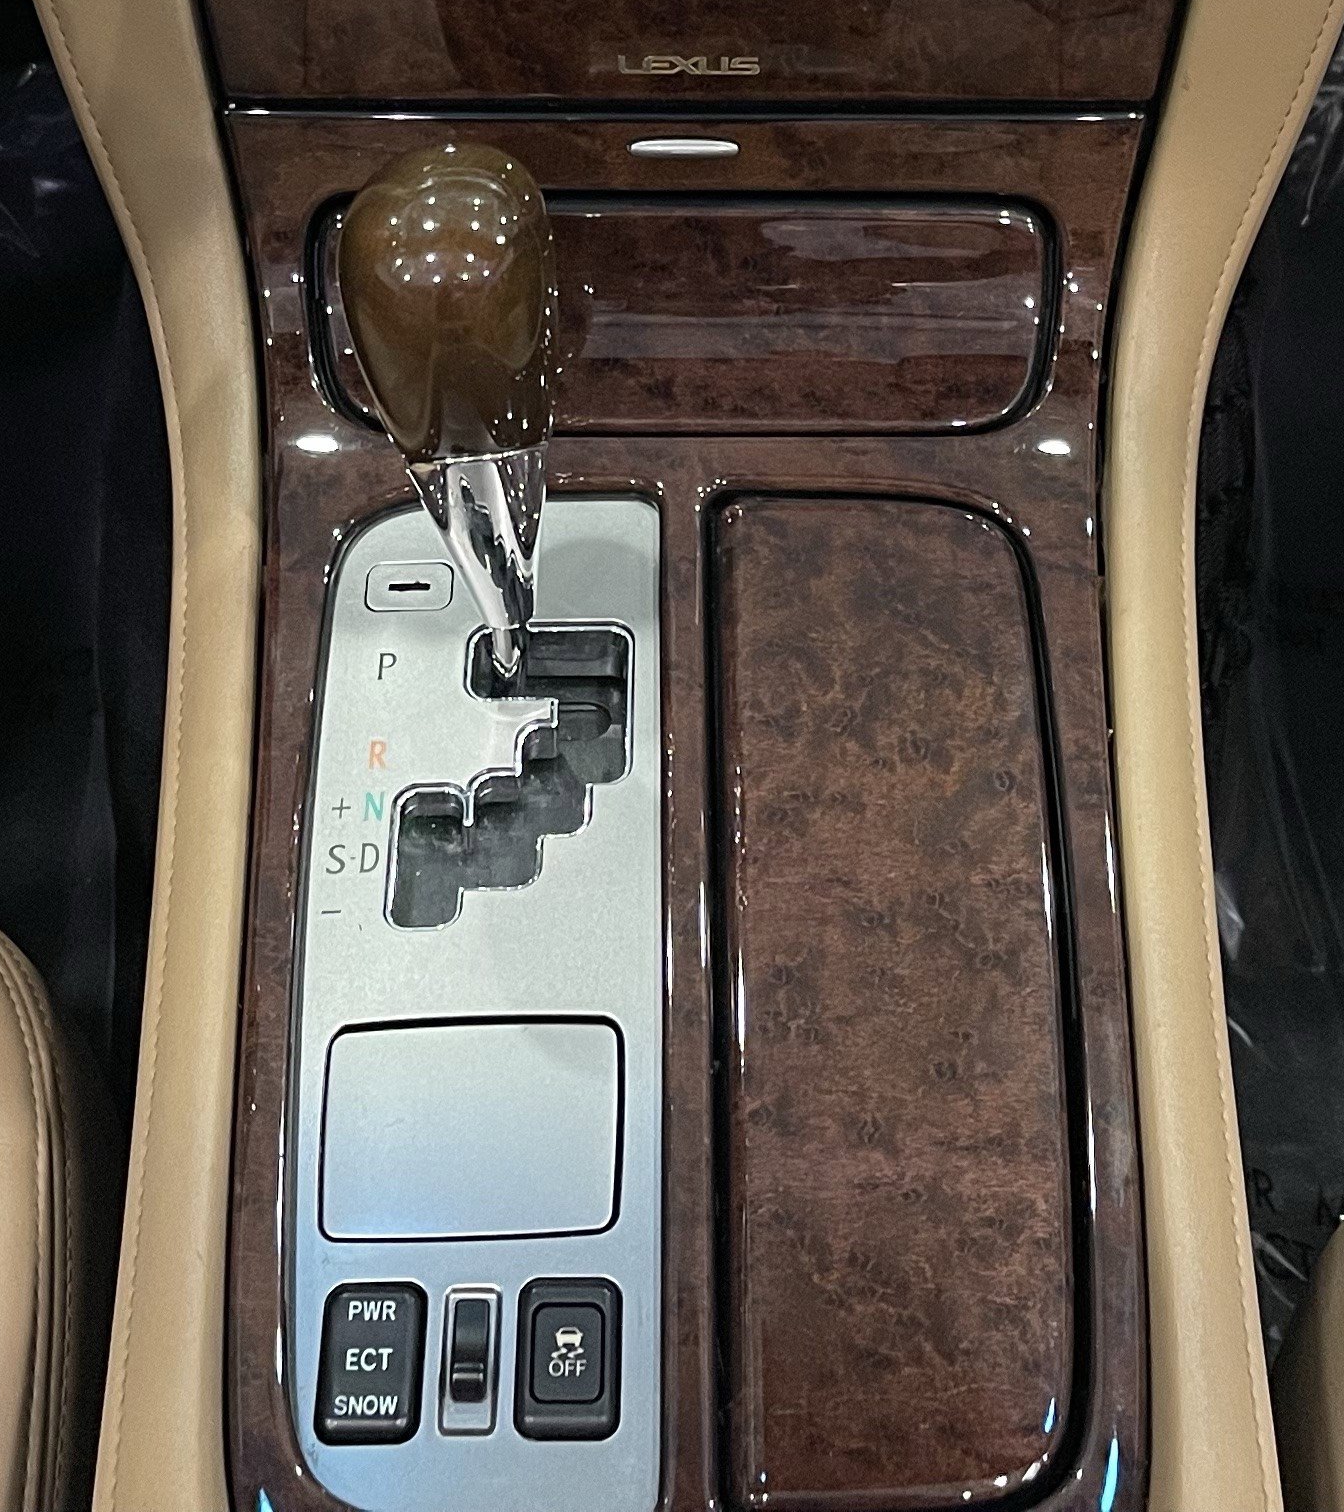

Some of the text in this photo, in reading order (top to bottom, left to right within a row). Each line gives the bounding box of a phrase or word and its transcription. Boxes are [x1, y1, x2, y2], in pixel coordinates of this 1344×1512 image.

[618, 55, 760, 75] LEXUS
[378, 653, 396, 680] P
[369, 741, 386, 769] R
[363, 791, 385, 821] N
[349, 1301, 396, 1321] PWR
[346, 1348, 393, 1371] ECT
[548, 1357, 587, 1377] OFF
[334, 1395, 397, 1415] SNOW
